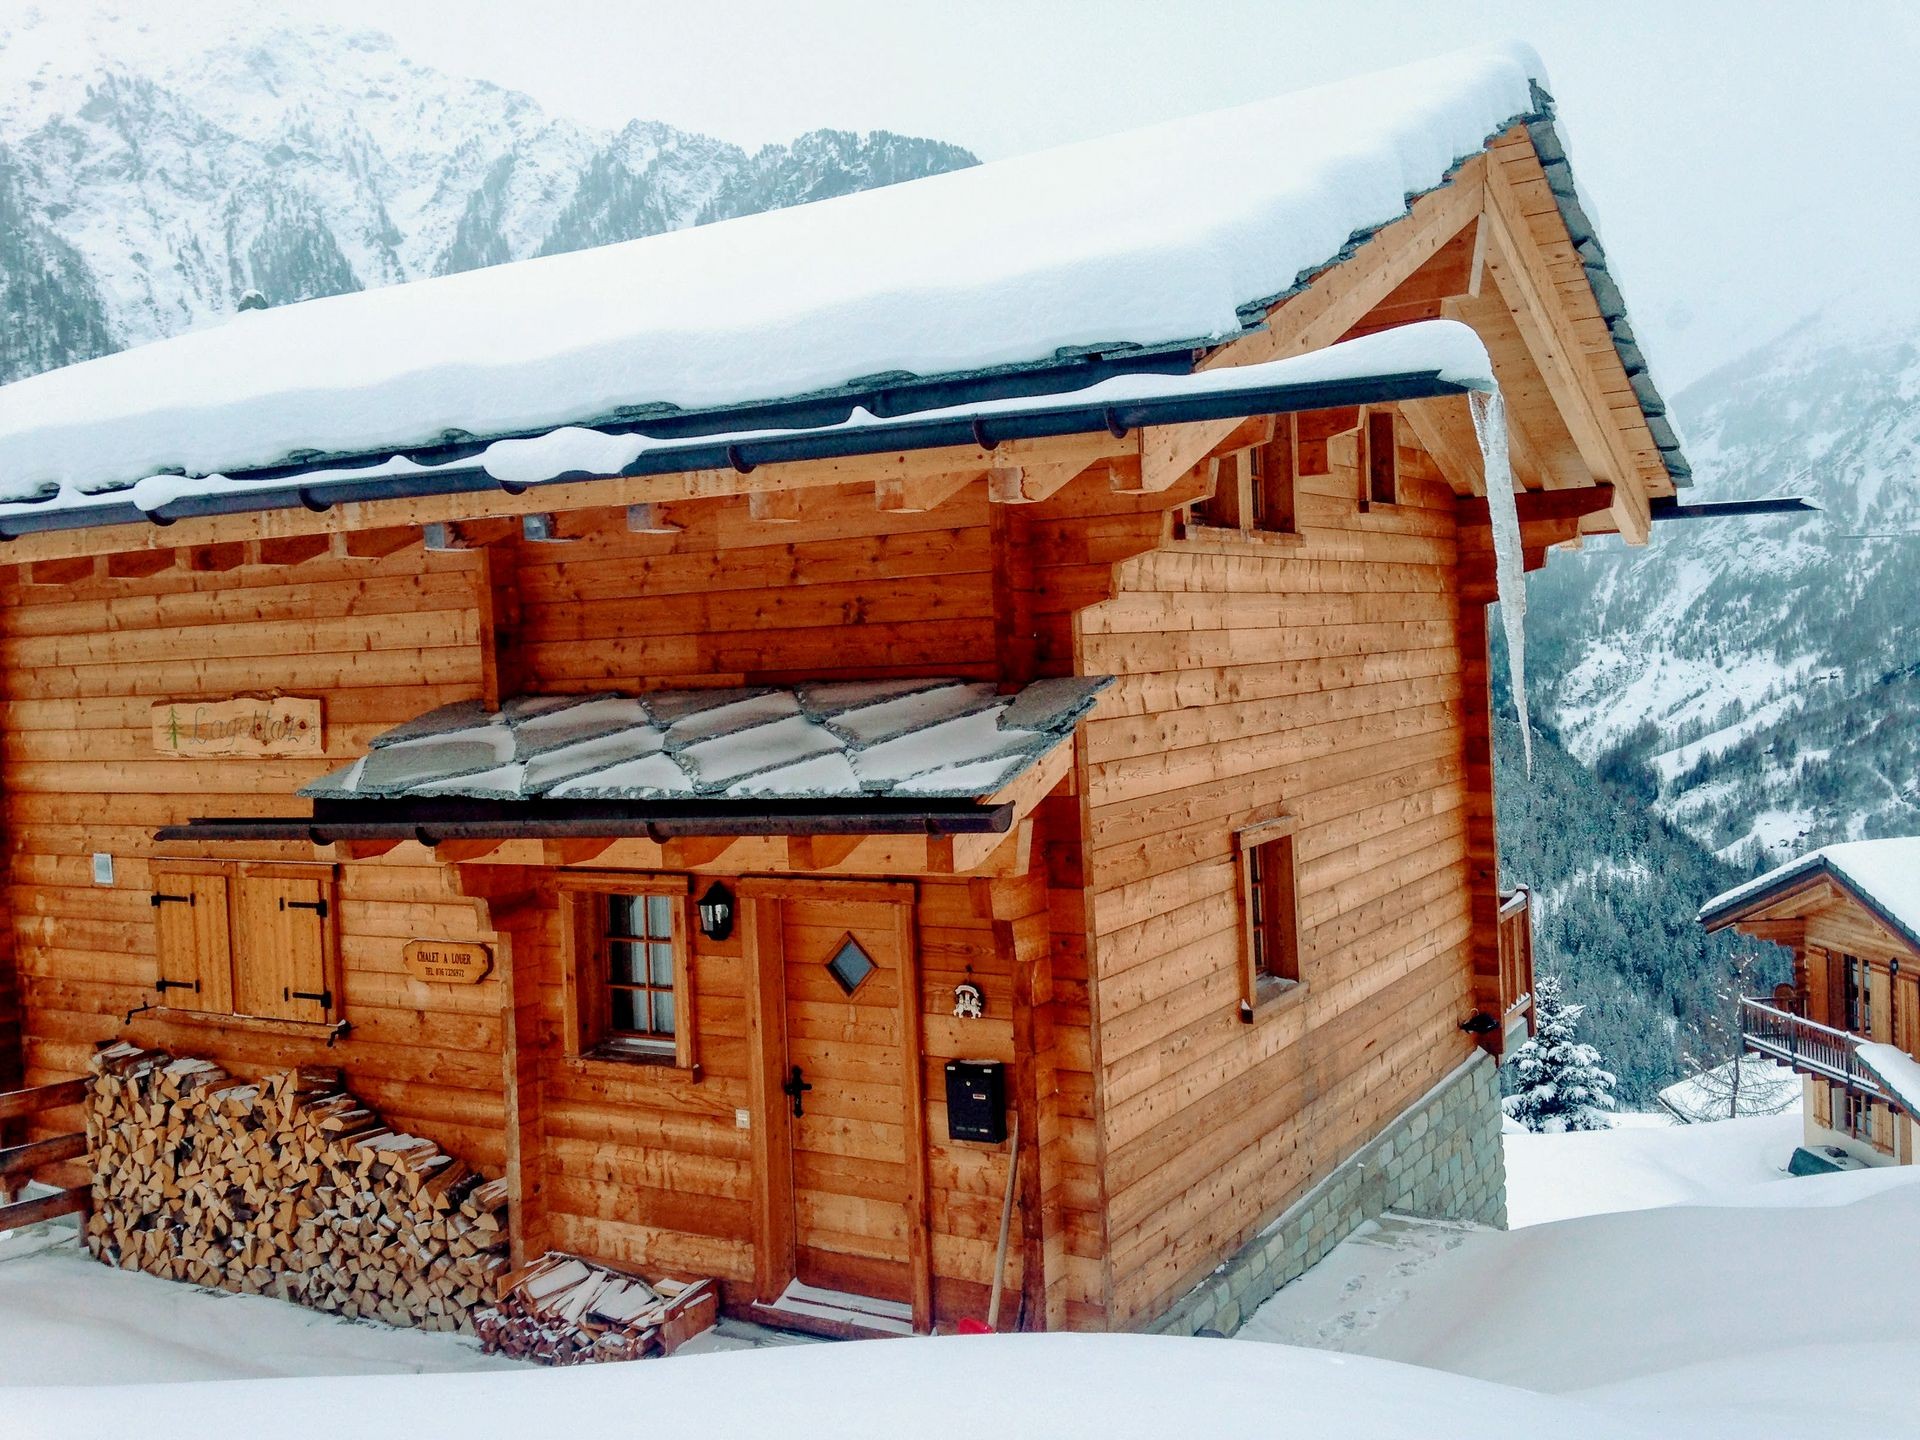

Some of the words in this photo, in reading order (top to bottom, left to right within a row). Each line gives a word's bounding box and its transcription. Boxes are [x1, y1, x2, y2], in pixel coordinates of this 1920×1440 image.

[417, 952, 439, 962] CHALET
[443, 954, 448, 964] A
[452, 954, 472, 964] LOUER
